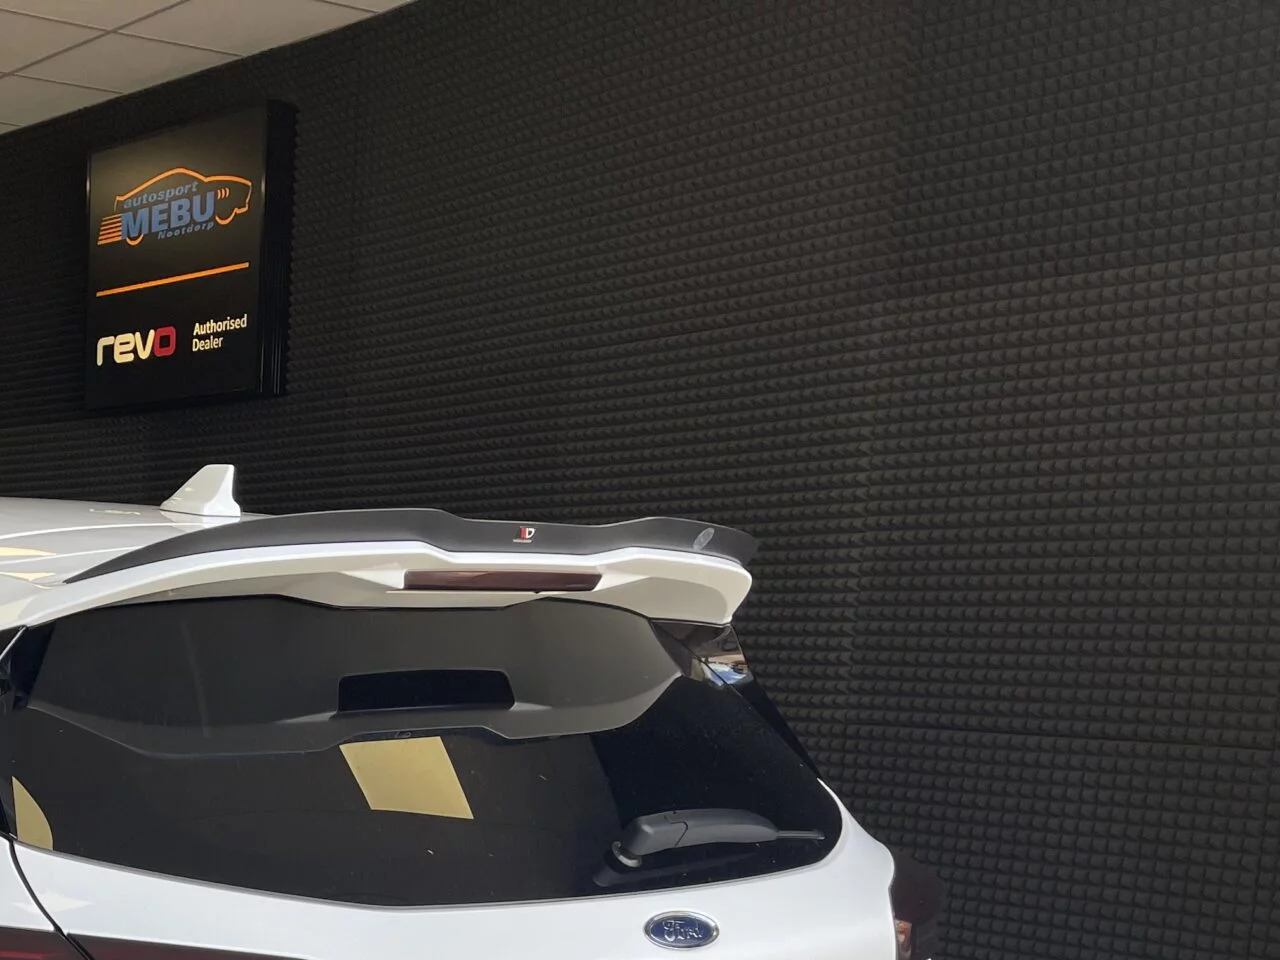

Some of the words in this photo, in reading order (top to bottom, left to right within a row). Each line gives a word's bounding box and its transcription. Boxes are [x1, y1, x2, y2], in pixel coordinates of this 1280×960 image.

[123, 181, 199, 209] autosport
[121, 191, 215, 240] MEBU
[157, 221, 215, 240] Nootdorp
[97, 326, 176, 367] revo
[193, 314, 248, 337] Authorised
[192, 335, 224, 352] Dealer
